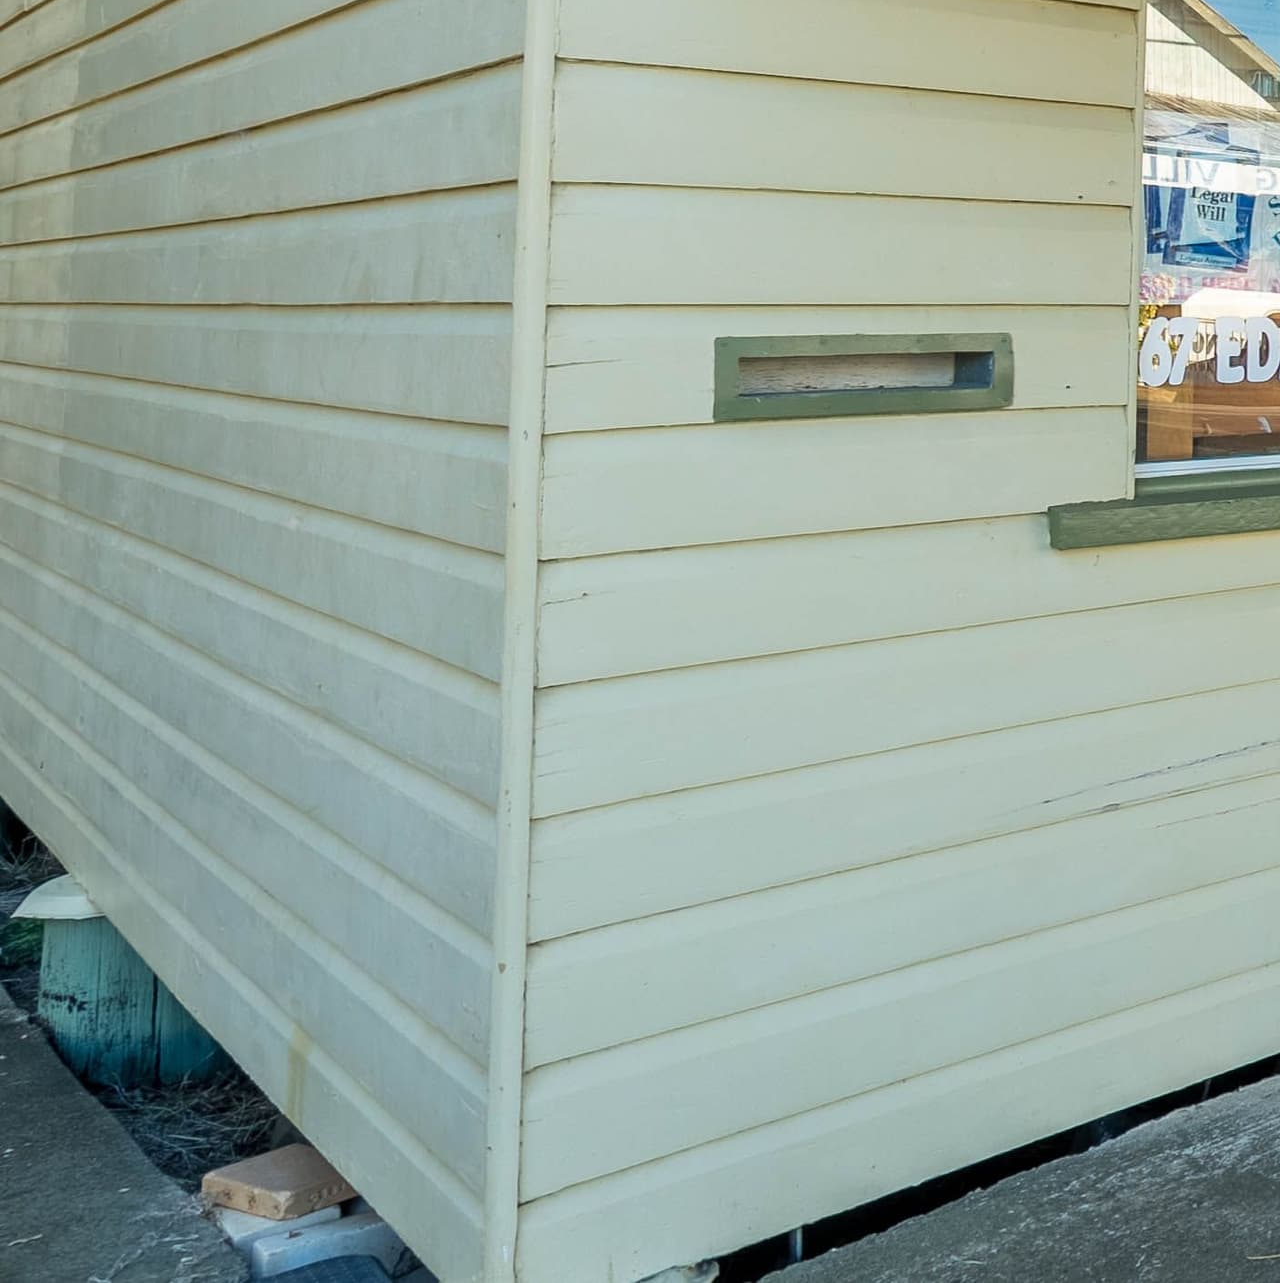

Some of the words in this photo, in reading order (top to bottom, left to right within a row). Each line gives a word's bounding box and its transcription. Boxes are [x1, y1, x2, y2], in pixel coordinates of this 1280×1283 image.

[1191, 186, 1234, 205] Legal
[1196, 203, 1226, 222] Will
[1139, 316, 1198, 388] 67
